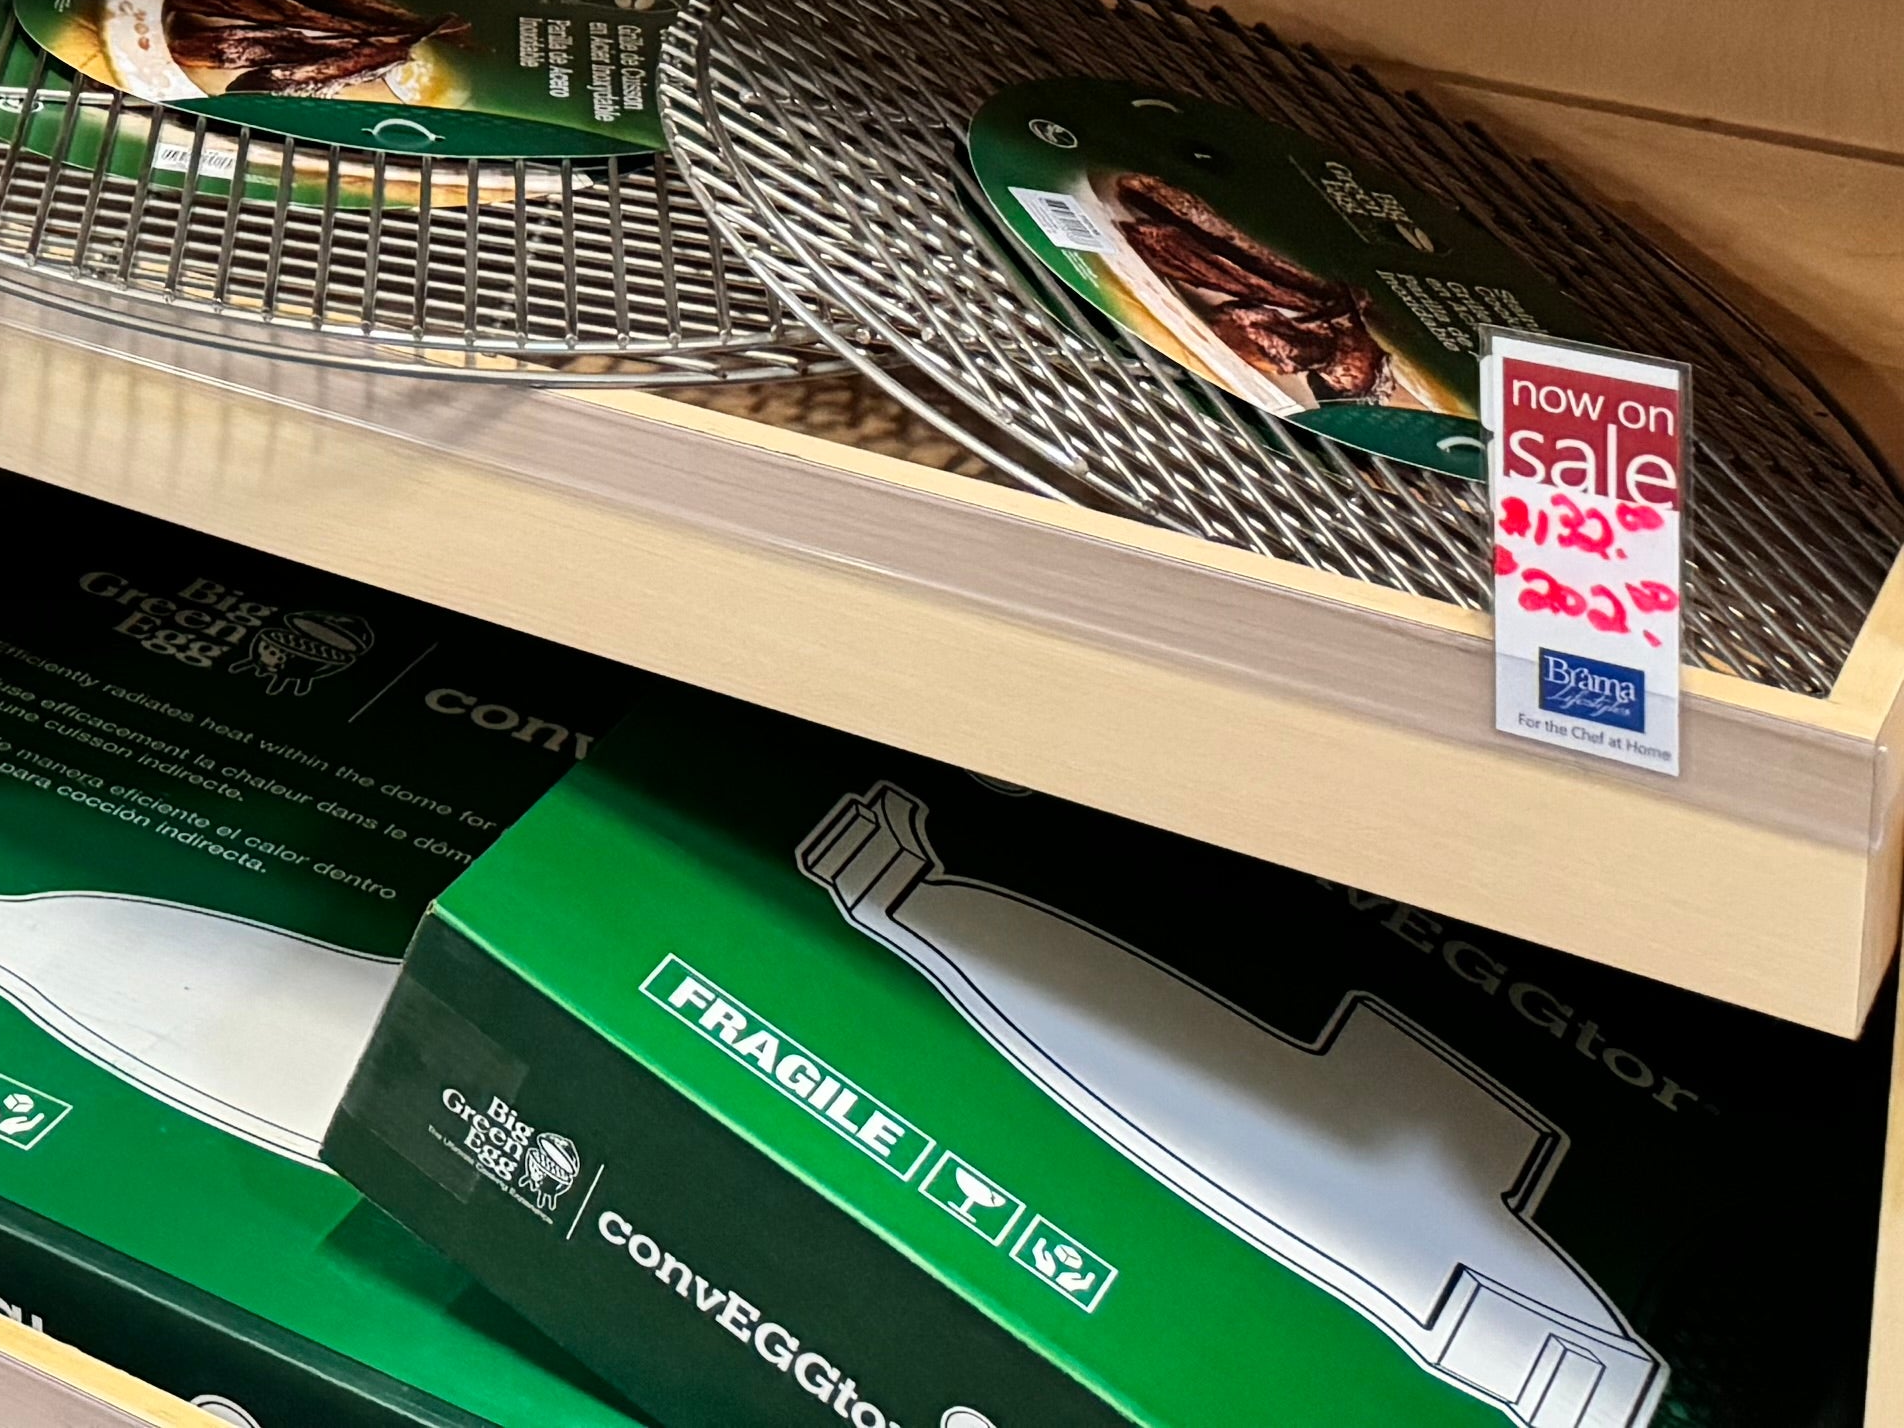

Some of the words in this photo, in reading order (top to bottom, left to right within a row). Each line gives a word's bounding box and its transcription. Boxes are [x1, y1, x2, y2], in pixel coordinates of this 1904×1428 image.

[1511, 379, 1605, 421] now
[1618, 400, 1675, 436] on
[1509, 423, 1677, 511] sale
[78, 571, 248, 644] Green
[177, 576, 278, 627] Big
[112, 611, 232, 669] Egg
[1544, 655, 1636, 704] Brama
[41, 697, 191, 761] efficacement
[193, 752, 216, 771] la
[221, 766, 313, 805] chaleur
[316, 798, 379, 830] dans
[383, 823, 408, 841] le
[413, 836, 473, 865] dôm
[43, 719, 134, 759] cuisson
[136, 751, 245, 802] indirecte.
[103, 679, 194, 723] radiates
[199, 716, 255, 744] heat
[260, 739, 331, 772] within
[336, 765, 375, 789] the
[380, 783, 453, 816] dome
[460, 810, 497, 833] for
[16, 747, 105, 789] manera
[110, 784, 211, 828] eficiente
[216, 825, 242, 840] el
[244, 836, 311, 865] calor
[313, 861, 397, 899] dentro
[56, 784, 151, 827] cocción
[155, 821, 267, 873] indirecta.
[668, 975, 906, 1158] FRAGILE
[442, 1088, 523, 1161] Green
[464, 1125, 518, 1181] Egg
[487, 1096, 534, 1146] Big
